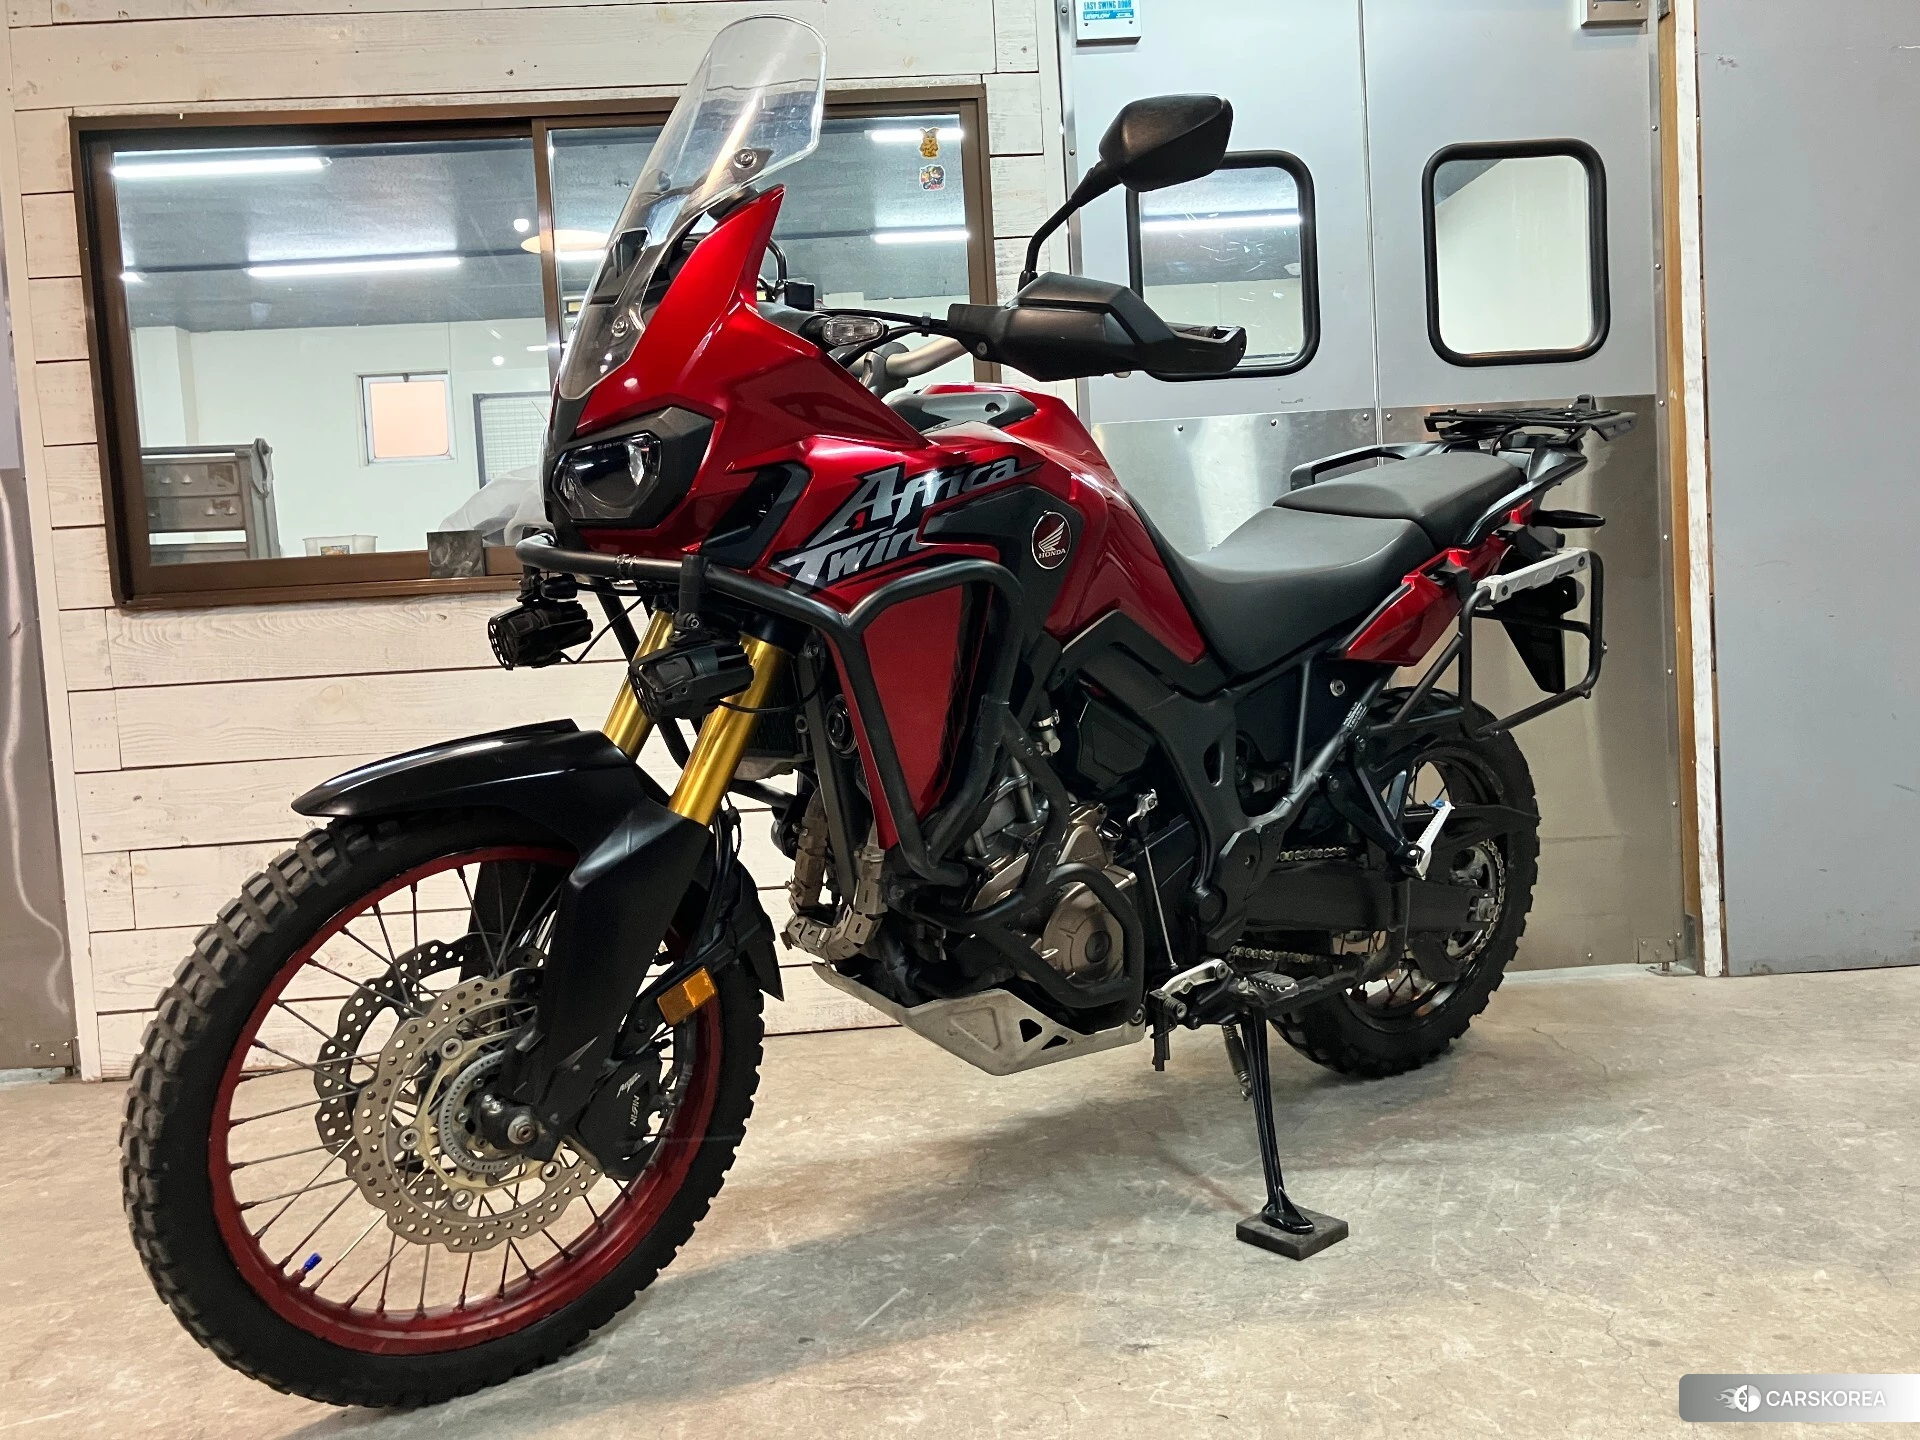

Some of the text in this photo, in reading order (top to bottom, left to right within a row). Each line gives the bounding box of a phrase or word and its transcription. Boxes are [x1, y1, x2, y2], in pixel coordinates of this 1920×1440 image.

[1083, 1, 1096, 10] EASY
[1098, 0, 1116, 9] SWING
[806, 458, 1044, 548] Africa
[779, 527, 933, 586] Twin
[1039, 548, 1066, 559] HONDA
